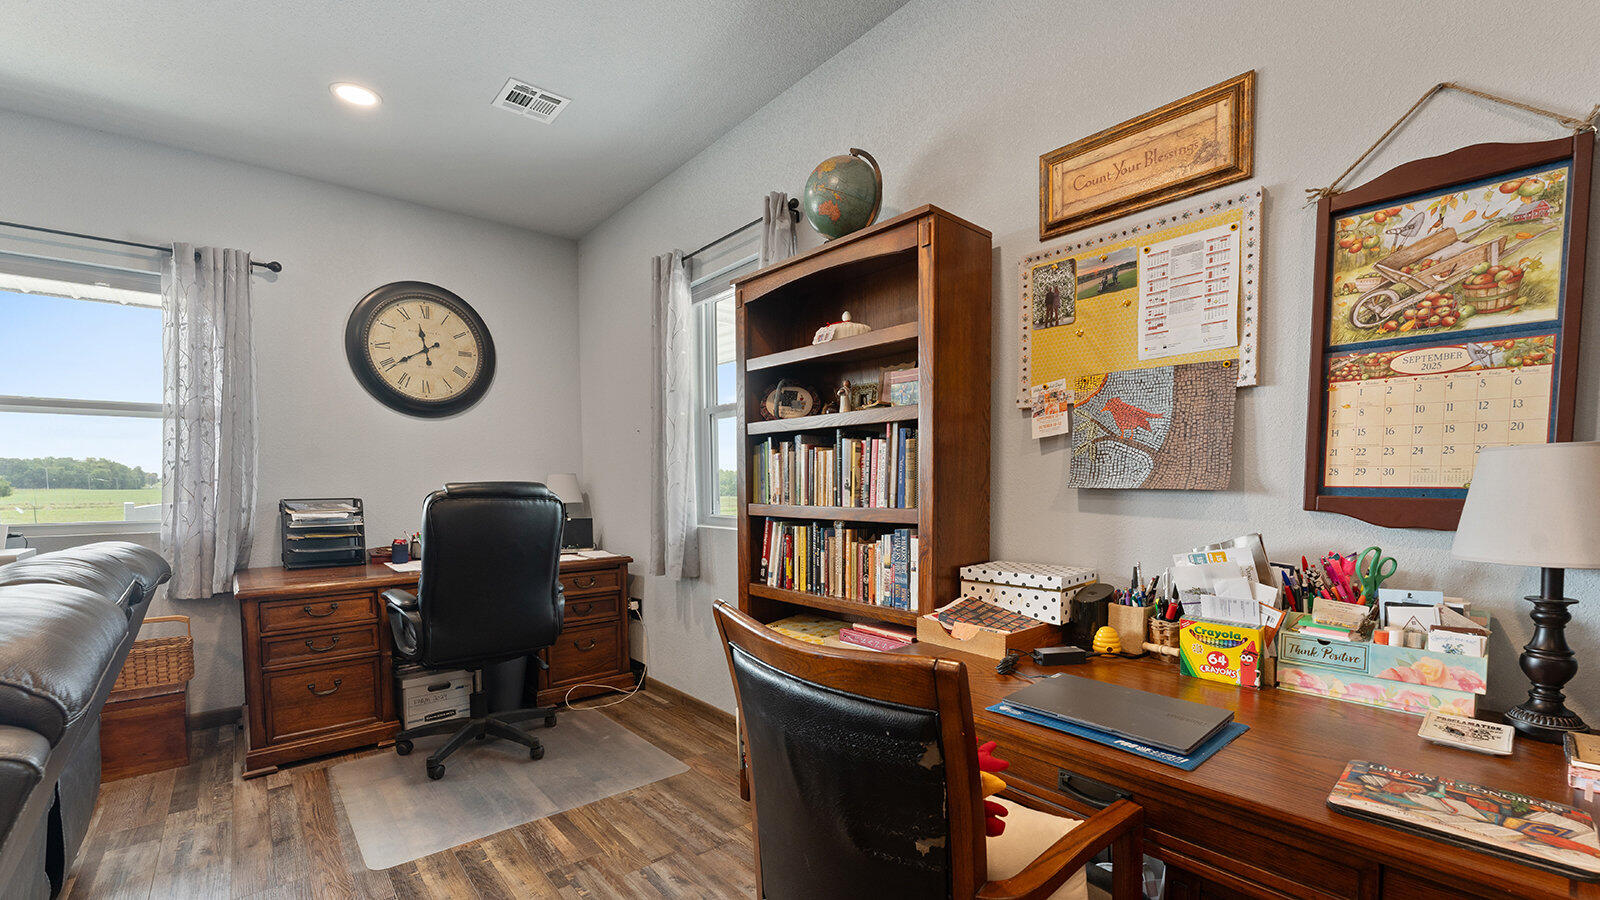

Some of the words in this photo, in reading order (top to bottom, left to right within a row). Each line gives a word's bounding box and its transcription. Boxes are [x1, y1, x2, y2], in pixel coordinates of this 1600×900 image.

[1073, 171, 1112, 191] Count
[1113, 160, 1142, 181] Your
[1144, 141, 1199, 168] Blessings
[1402, 351, 1463, 365] SEPTEMBER
[1421, 362, 1442, 371] 2025
[1386, 386, 1393, 395] 2
[1415, 384, 1423, 393] 3
[1446, 381, 1453, 390] 4
[1480, 379, 1487, 388] 5
[1514, 376, 1522, 385] 6
[1332, 409, 1337, 418] 7
[1359, 408, 1365, 417] 8
[1385, 406, 1393, 415] 9
[1415, 405, 1426, 413] 10
[1446, 402, 1454, 412] 11
[1478, 401, 1489, 410] 12
[1512, 399, 1524, 408] 13
[1331, 429, 1339, 438] 14
[1357, 428, 1366, 436] 15
[1385, 427, 1395, 435] 16
[1414, 425, 1424, 434] 17
[1445, 424, 1456, 433] 18
[1477, 423, 1488, 432] 19
[1510, 421, 1525, 431] 20
[1329, 448, 1338, 457] 21
[1355, 447, 1367, 456] 22
[1383, 447, 1395, 456] 23
[1412, 446, 1424, 455] 24
[1442, 445, 1456, 454] 25
[1328, 468, 1339, 476] 28
[1355, 467, 1367, 476] 29
[1382, 467, 1395, 476] 30
[1193, 625, 1242, 641] Crayola
[1207, 653, 1227, 666] 64
[1288, 642, 1319, 658] Think
[1321, 646, 1362, 665] Positive
[1199, 664, 1237, 679] CRAYONS
[1369, 763, 1436, 783] LIBRARY
[1459, 783, 1563, 812] CONGRESS
